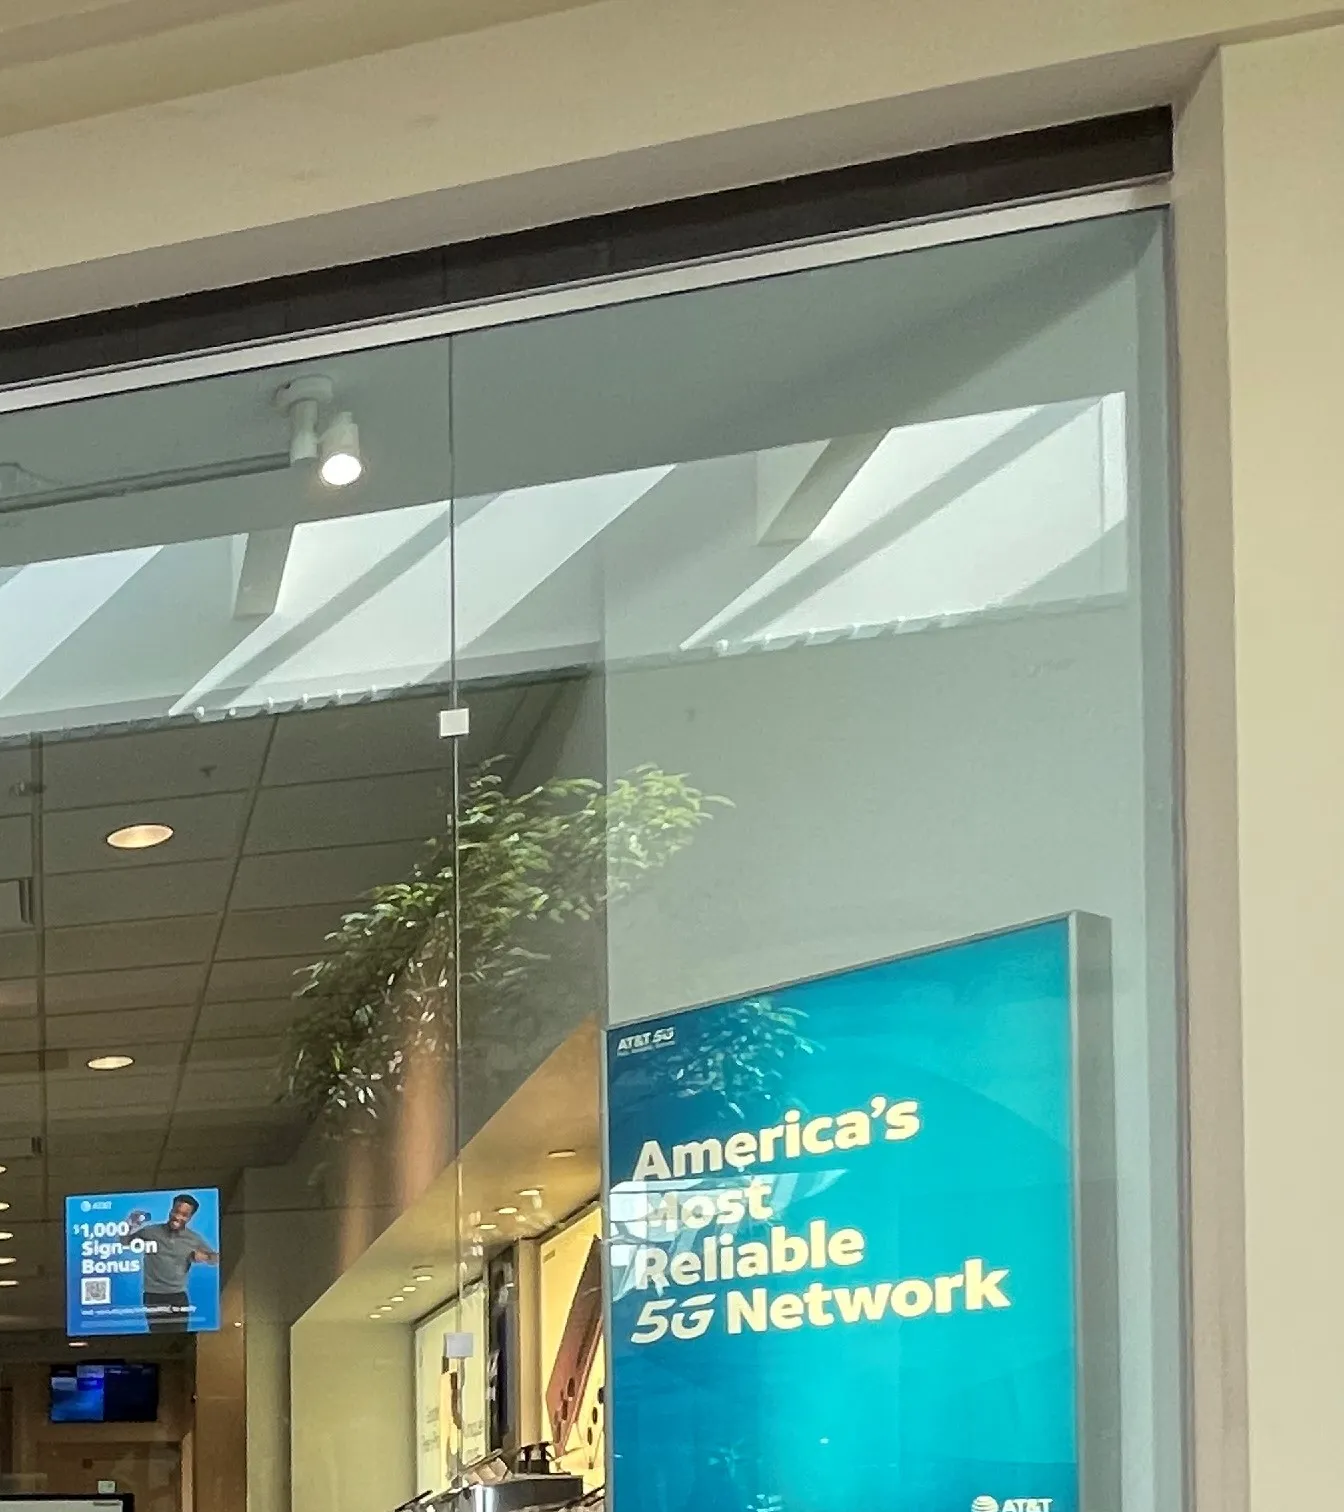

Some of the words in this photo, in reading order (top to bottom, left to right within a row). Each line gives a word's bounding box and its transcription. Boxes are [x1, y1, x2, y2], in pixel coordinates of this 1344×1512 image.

[618, 1032, 652, 1050] AT&T
[652, 1027, 675, 1043] 5G
[632, 1096, 921, 1182] America's
[644, 1174, 775, 1234] Most
[73, 1221, 130, 1239] $1,000
[81, 1238, 158, 1259] Sign-On
[81, 1259, 141, 1274] Bonus
[635, 1219, 865, 1291] Reliable
[630, 1294, 717, 1344] 5G
[726, 1258, 1011, 1335] Network
